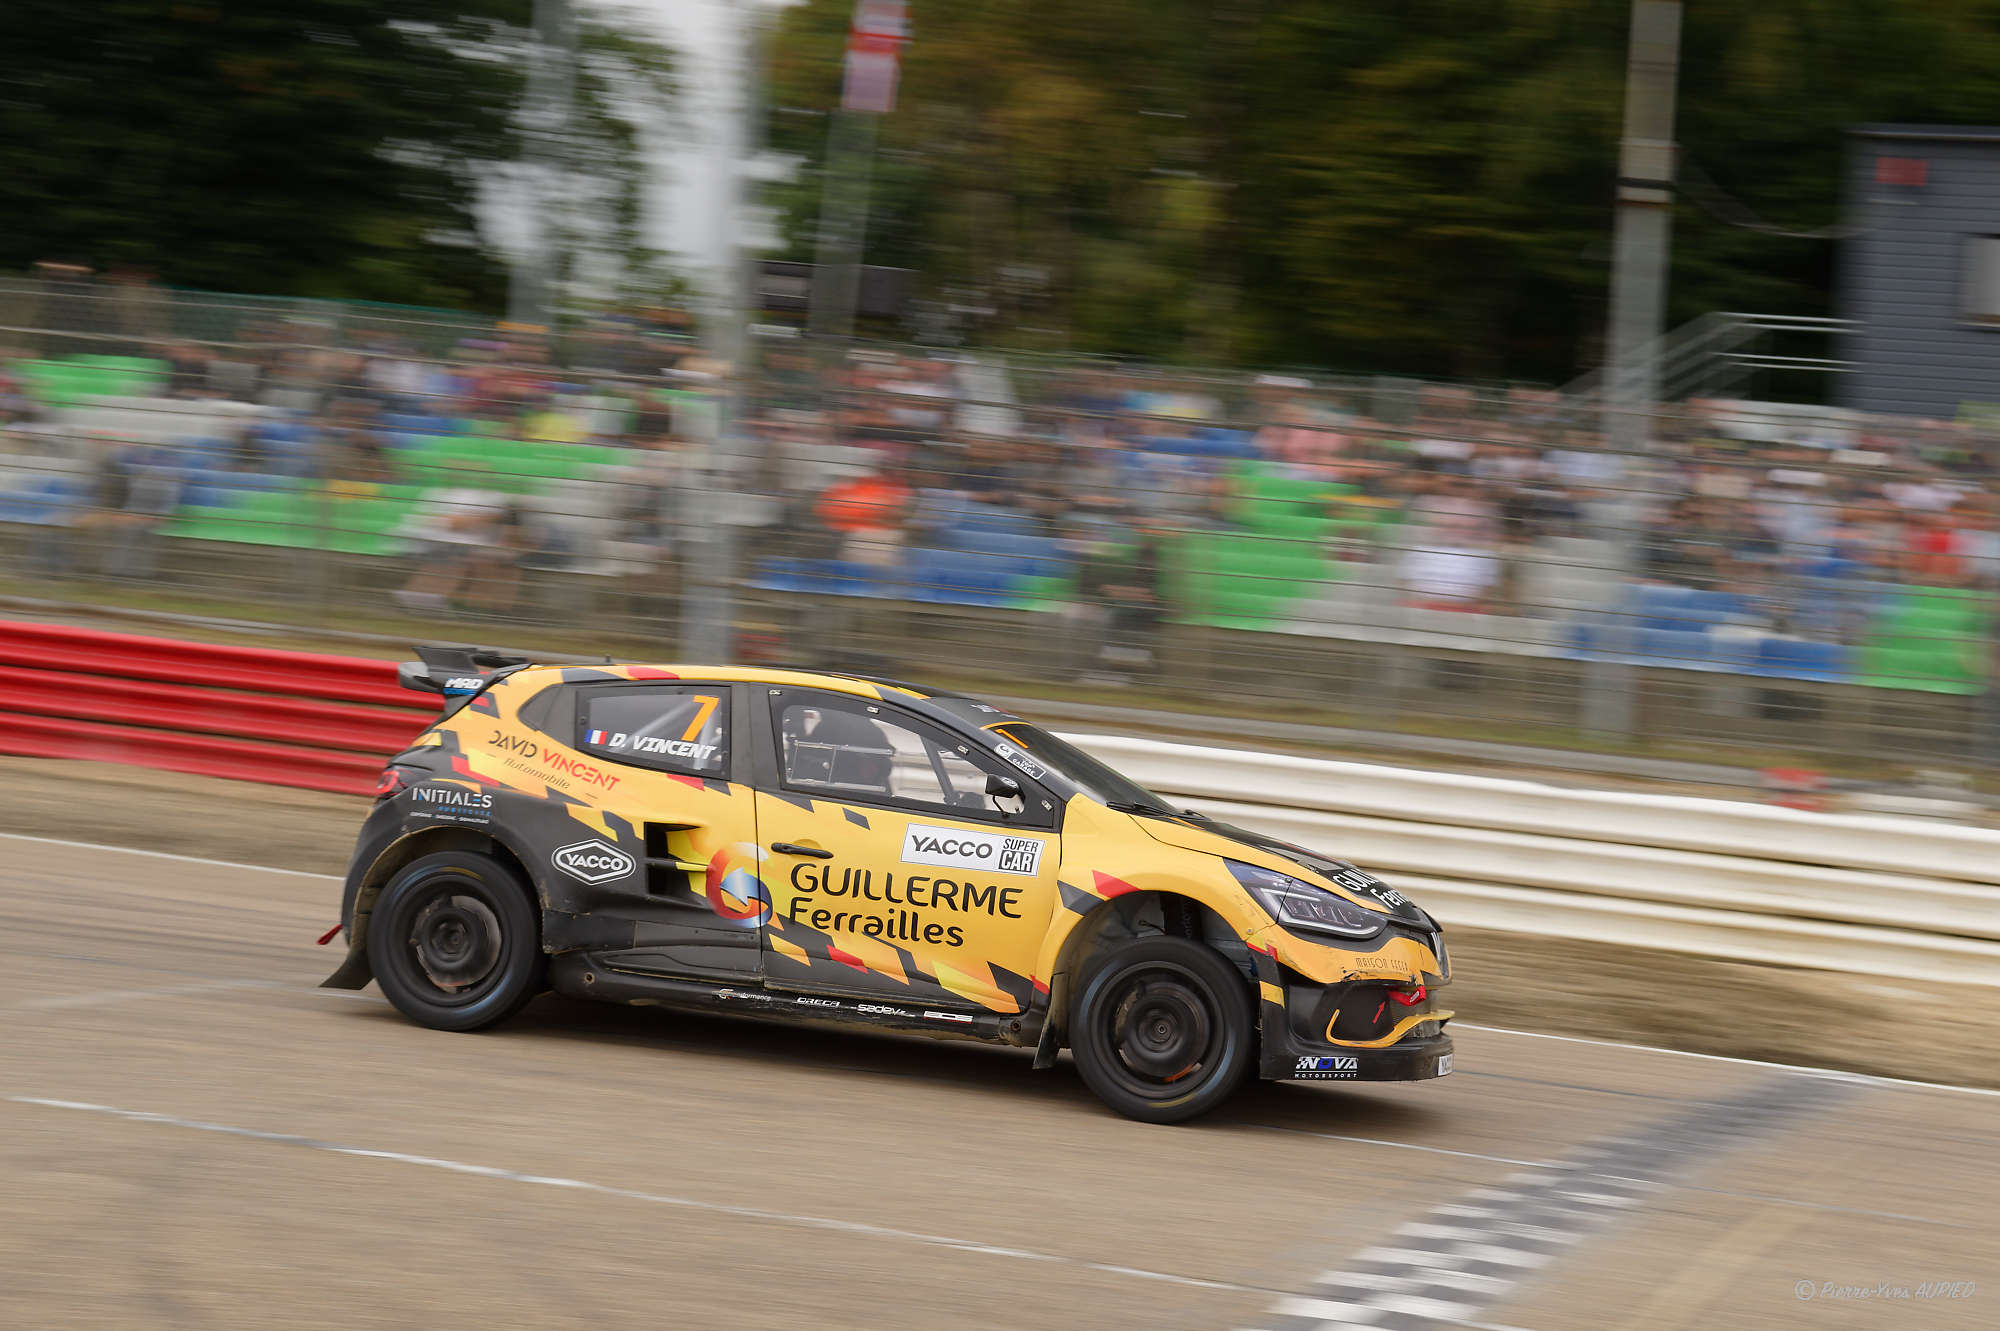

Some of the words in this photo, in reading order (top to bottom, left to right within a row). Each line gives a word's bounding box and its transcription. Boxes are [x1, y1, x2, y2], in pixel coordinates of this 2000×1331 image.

[681, 695, 720, 742] 7
[608, 732, 626, 748] D.
[633, 735, 718, 760] VINCENT
[488, 730, 538, 758] DAVID
[543, 748, 621, 791] VINCENT
[412, 787, 493, 808] INITIALES
[912, 835, 993, 859] YACCO
[1003, 838, 1039, 853] SUPER
[566, 853, 624, 871] YACCO
[1000, 850, 1035, 872] CAR
[791, 863, 1024, 918] GUILLERME
[790, 896, 965, 947] Ferrailles
